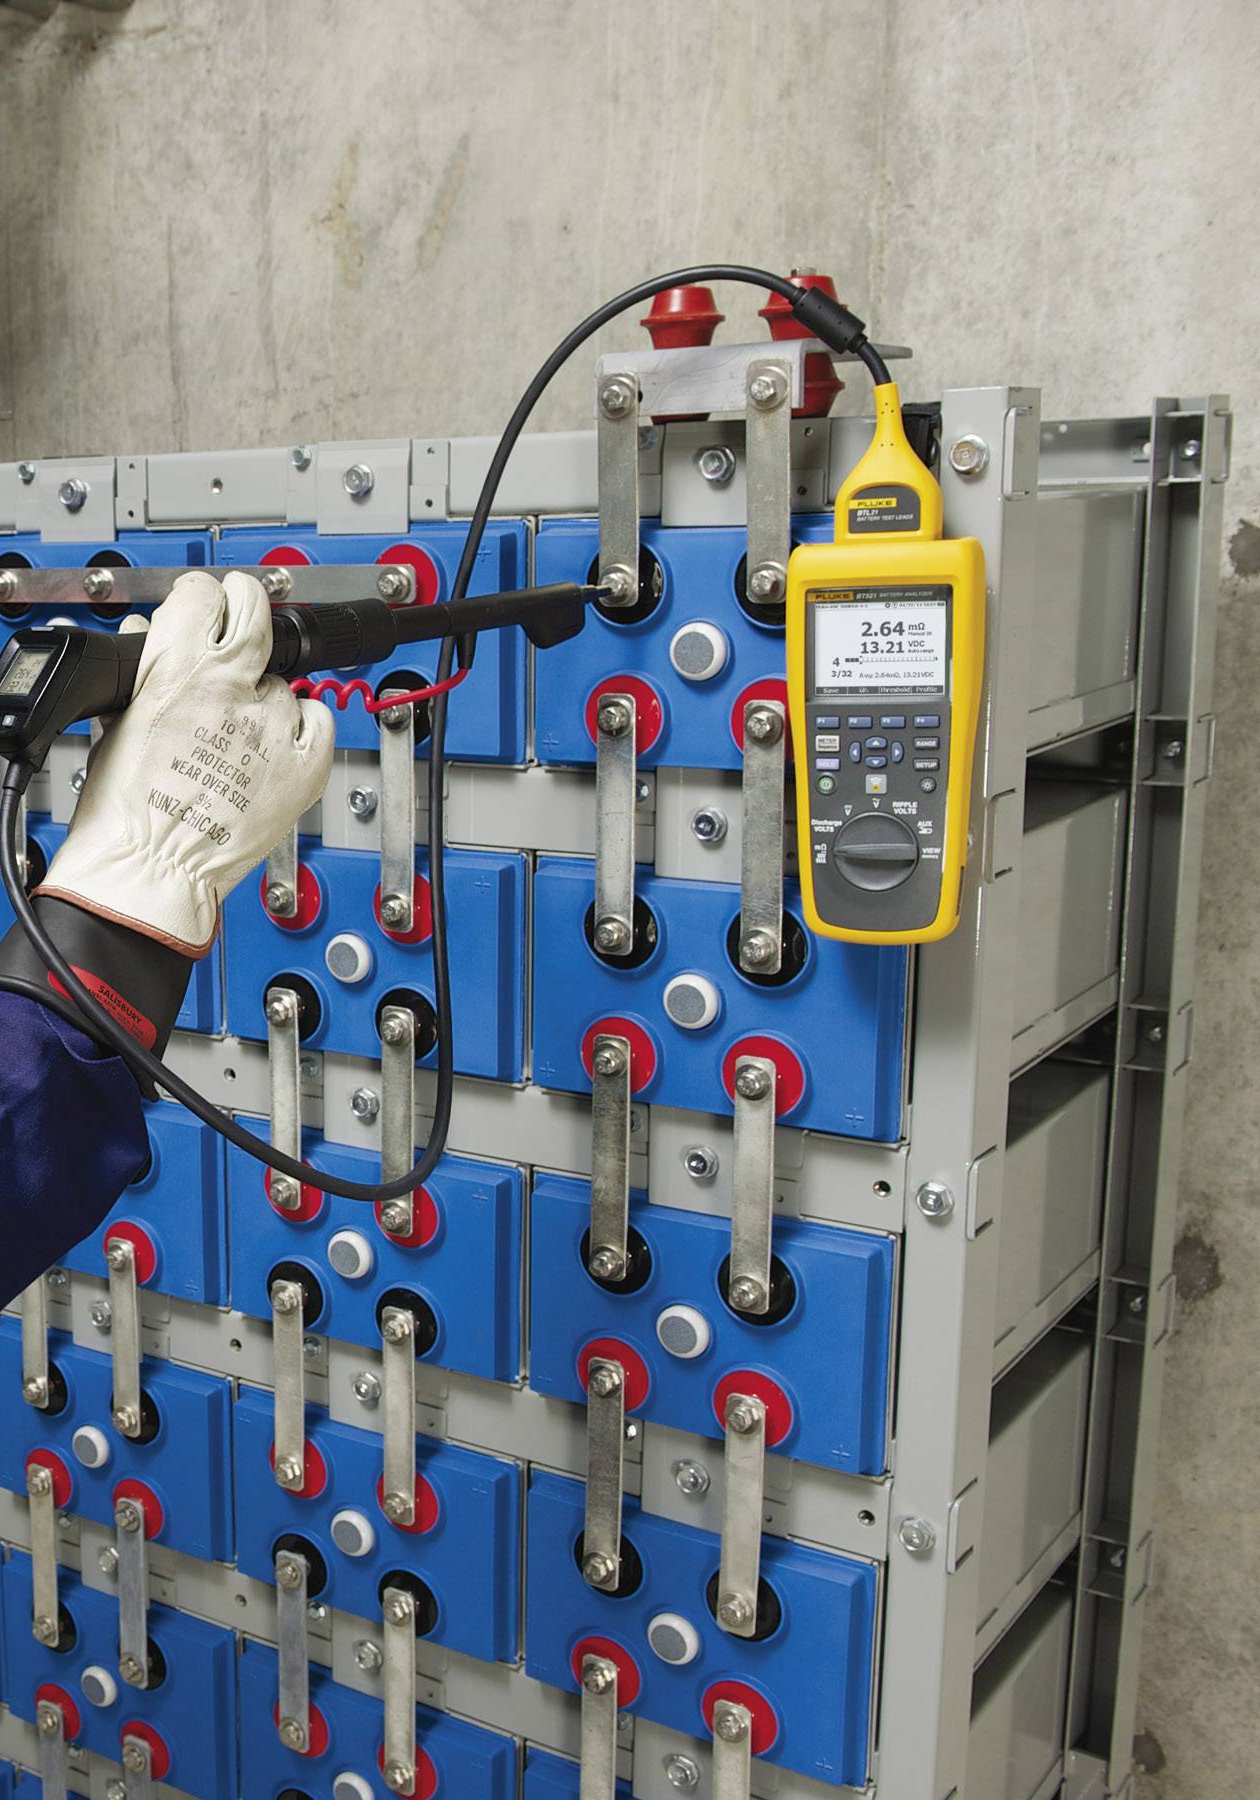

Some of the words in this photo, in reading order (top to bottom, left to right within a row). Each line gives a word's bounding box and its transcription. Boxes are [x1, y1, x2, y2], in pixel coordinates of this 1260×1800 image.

[861, 621, 905, 637] 2.64
[908, 622, 925, 631] mΩ
[860, 641, 904, 654] 13.21
[832, 657, 840, 667] 4
[831, 670, 852, 678] 3/32
[194, 726, 232, 753] CLASS
[191, 746, 251, 790] PROTECTOR
[171, 756, 202, 782] WEAR
[202, 773, 230, 798] OVER
[228, 790, 251, 813] SIZE
[147, 788, 232, 846] KUNZ-CHICAGO
[811, 818, 842, 828] Discharge
[98, 984, 142, 1025] SALISBURY
